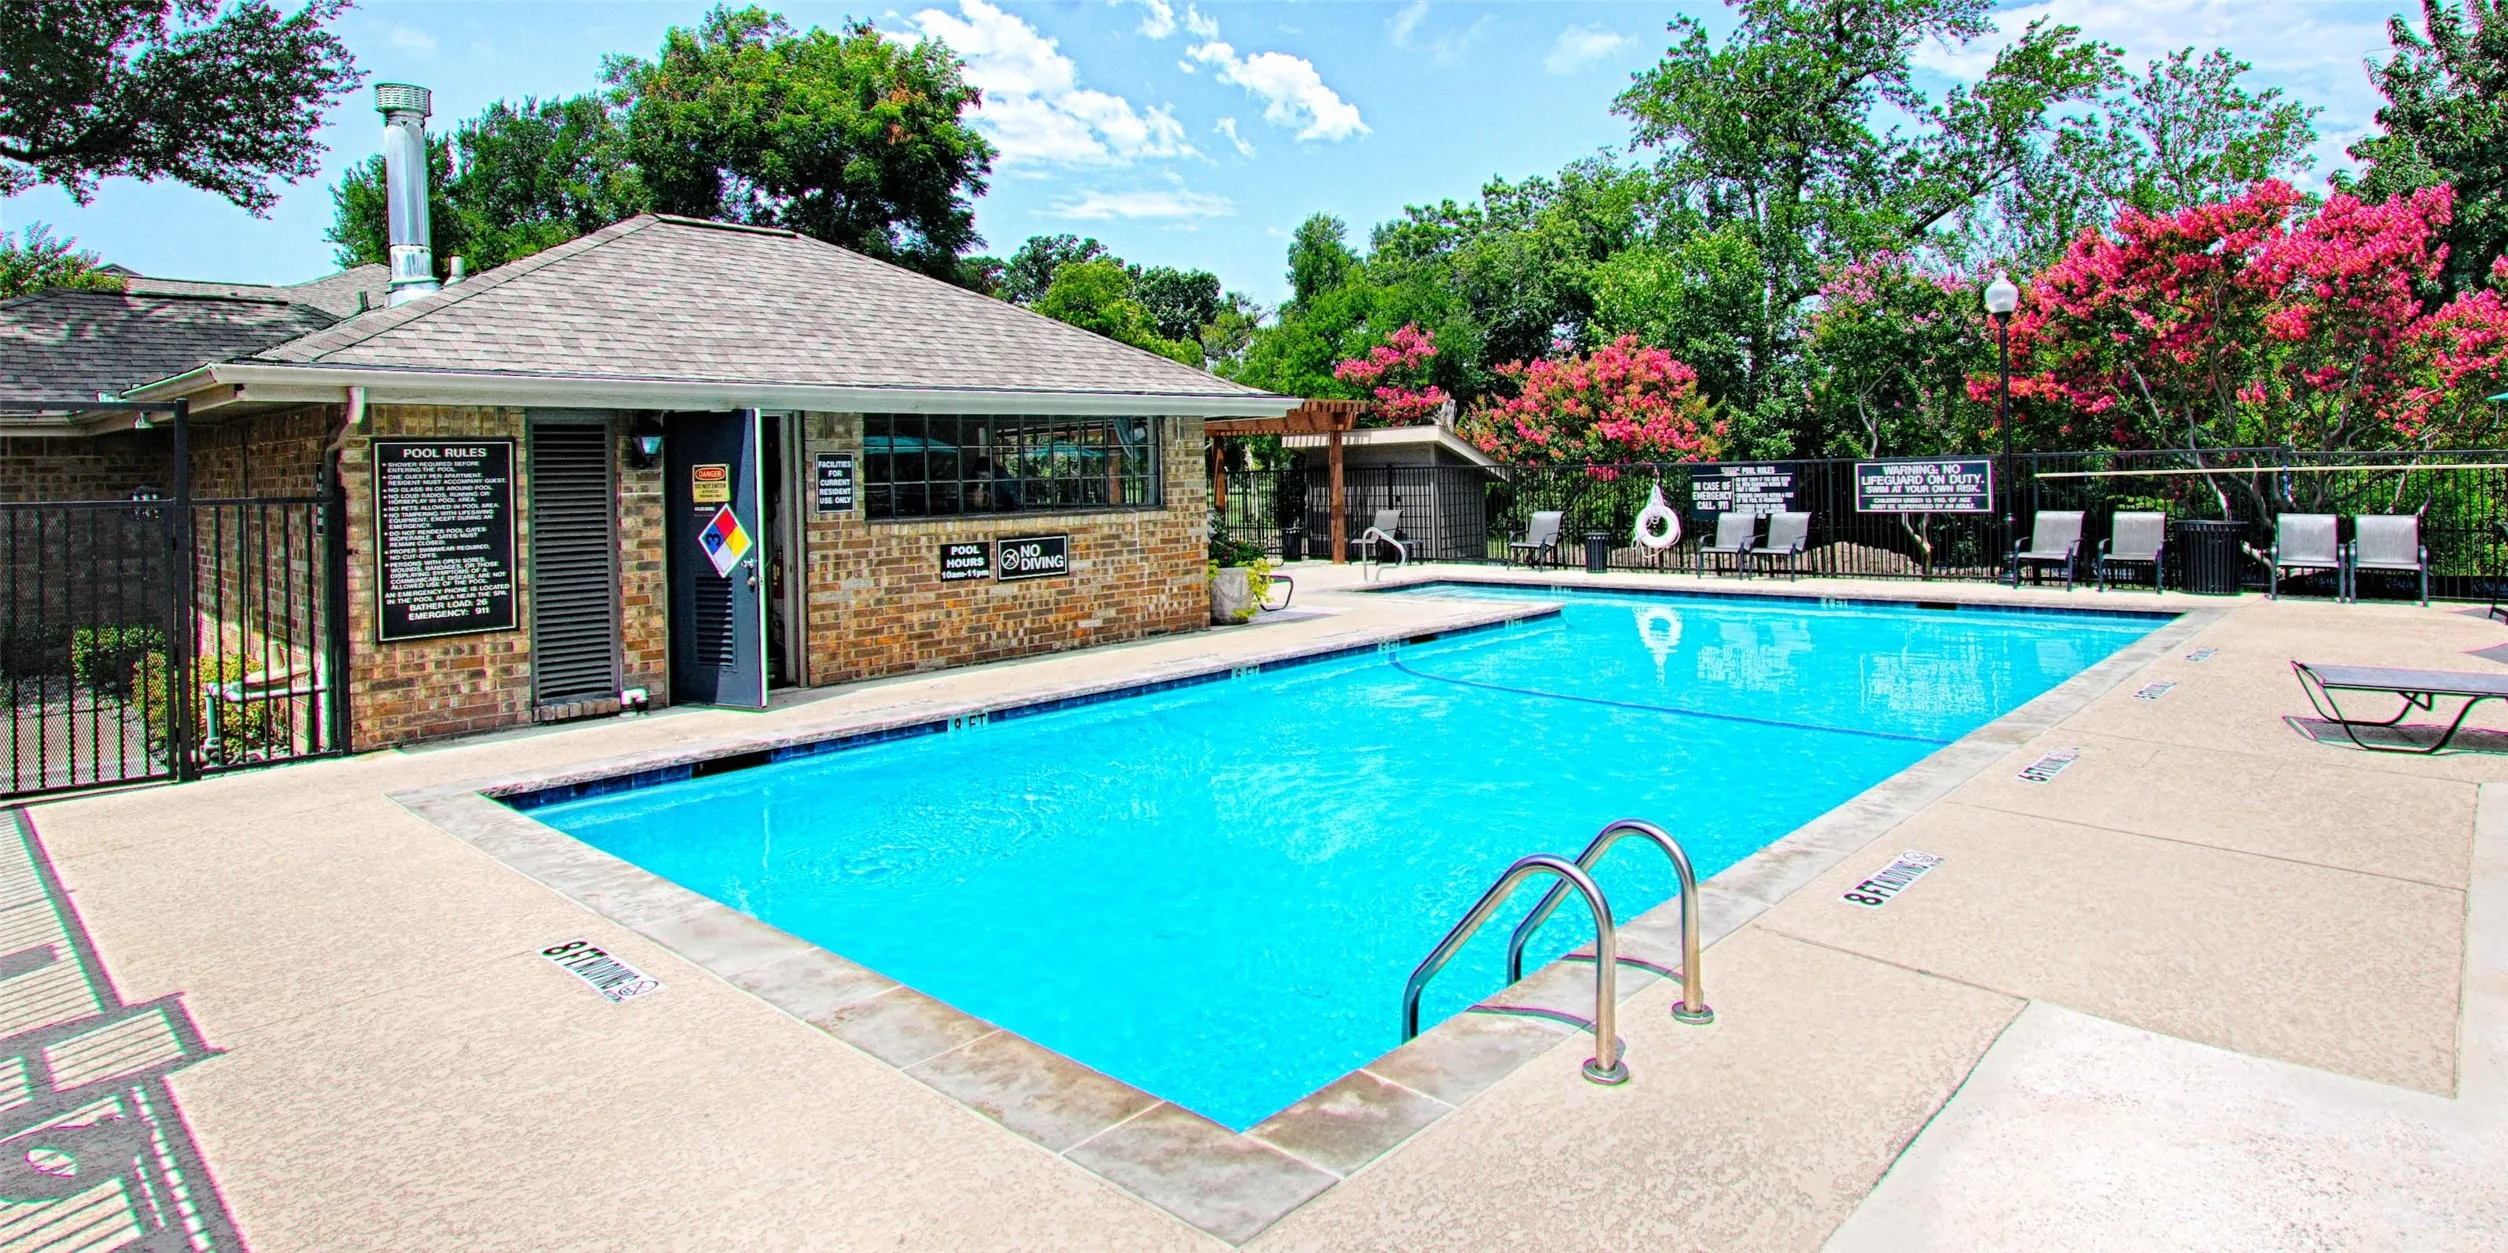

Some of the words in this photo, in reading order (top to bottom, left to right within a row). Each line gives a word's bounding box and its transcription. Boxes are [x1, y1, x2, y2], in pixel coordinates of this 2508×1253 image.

[403, 448, 440, 458] POOL
[444, 448, 487, 458] RULES
[1942, 465, 1960, 474] NO
[1861, 476, 1923, 485] LIFEGUARD
[1928, 475, 1945, 484] ON
[1949, 474, 1985, 484] DUTY.
[1693, 482, 1701, 490] IN
[1703, 482, 1720, 490] CASE
[1722, 481, 1731, 490] OF
[1906, 485, 1929, 493] YOUR
[1957, 484, 1980, 492] RISK.
[1693, 491, 1732, 500] EMERGENCY
[1718, 501, 1729, 509] 911
[951, 546, 980, 555] POOL
[1020, 544, 1040, 557] NO
[946, 557, 984, 568] HOURS
[1021, 555, 1064, 570] DIVING
[941, 569, 989, 579] 10am-11pm
[410, 602, 445, 612] BATHER
[448, 600, 473, 608] LOAD:
[409, 610, 469, 621] EMERGENCY:
[1856, 880, 1899, 897] FT
[1844, 894, 1883, 905] 8
[542, 941, 588, 956] 8
[554, 948, 608, 966] FT
